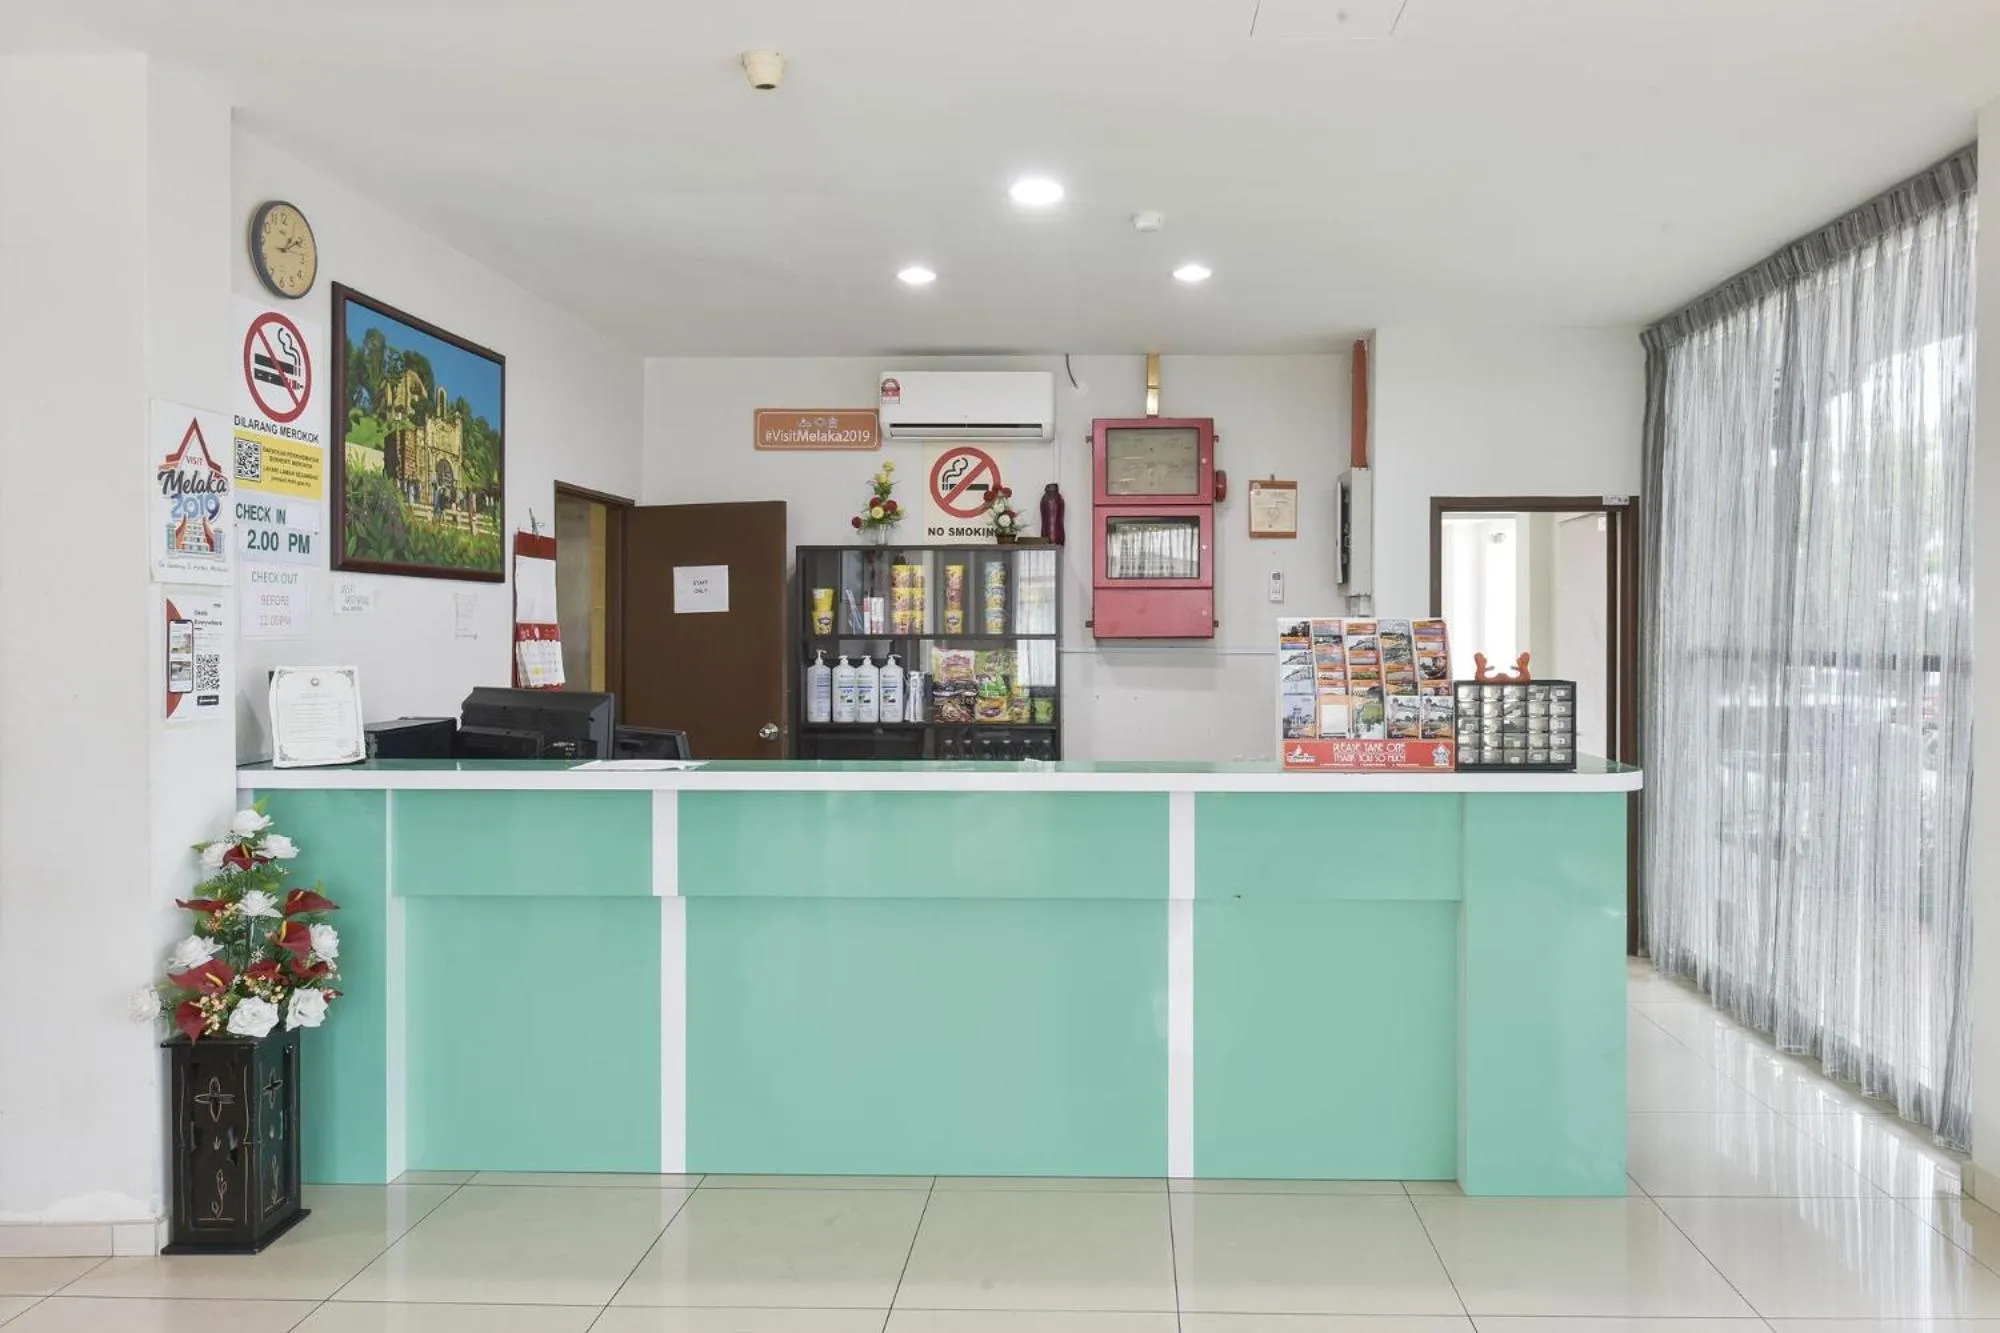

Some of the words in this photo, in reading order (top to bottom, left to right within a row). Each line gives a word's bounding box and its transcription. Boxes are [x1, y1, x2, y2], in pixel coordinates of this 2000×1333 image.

[234, 415, 278, 435] DILARANG
[280, 426, 319, 443] MEROKOK
[765, 429, 870, 442] #VisitMelaka2019
[157, 469, 227, 495] Melaka
[171, 493, 221, 521] 2019
[235, 503, 271, 523] CHECK
[276, 508, 286, 524] IN
[928, 527, 944, 536] NO
[247, 529, 279, 551] 2.00
[288, 533, 310, 554] PM
[251, 571, 279, 584] CHECK
[281, 573, 298, 585] OUT
[260, 594, 289, 606] BEFORE
[1359, 753, 1373, 762] YOU
